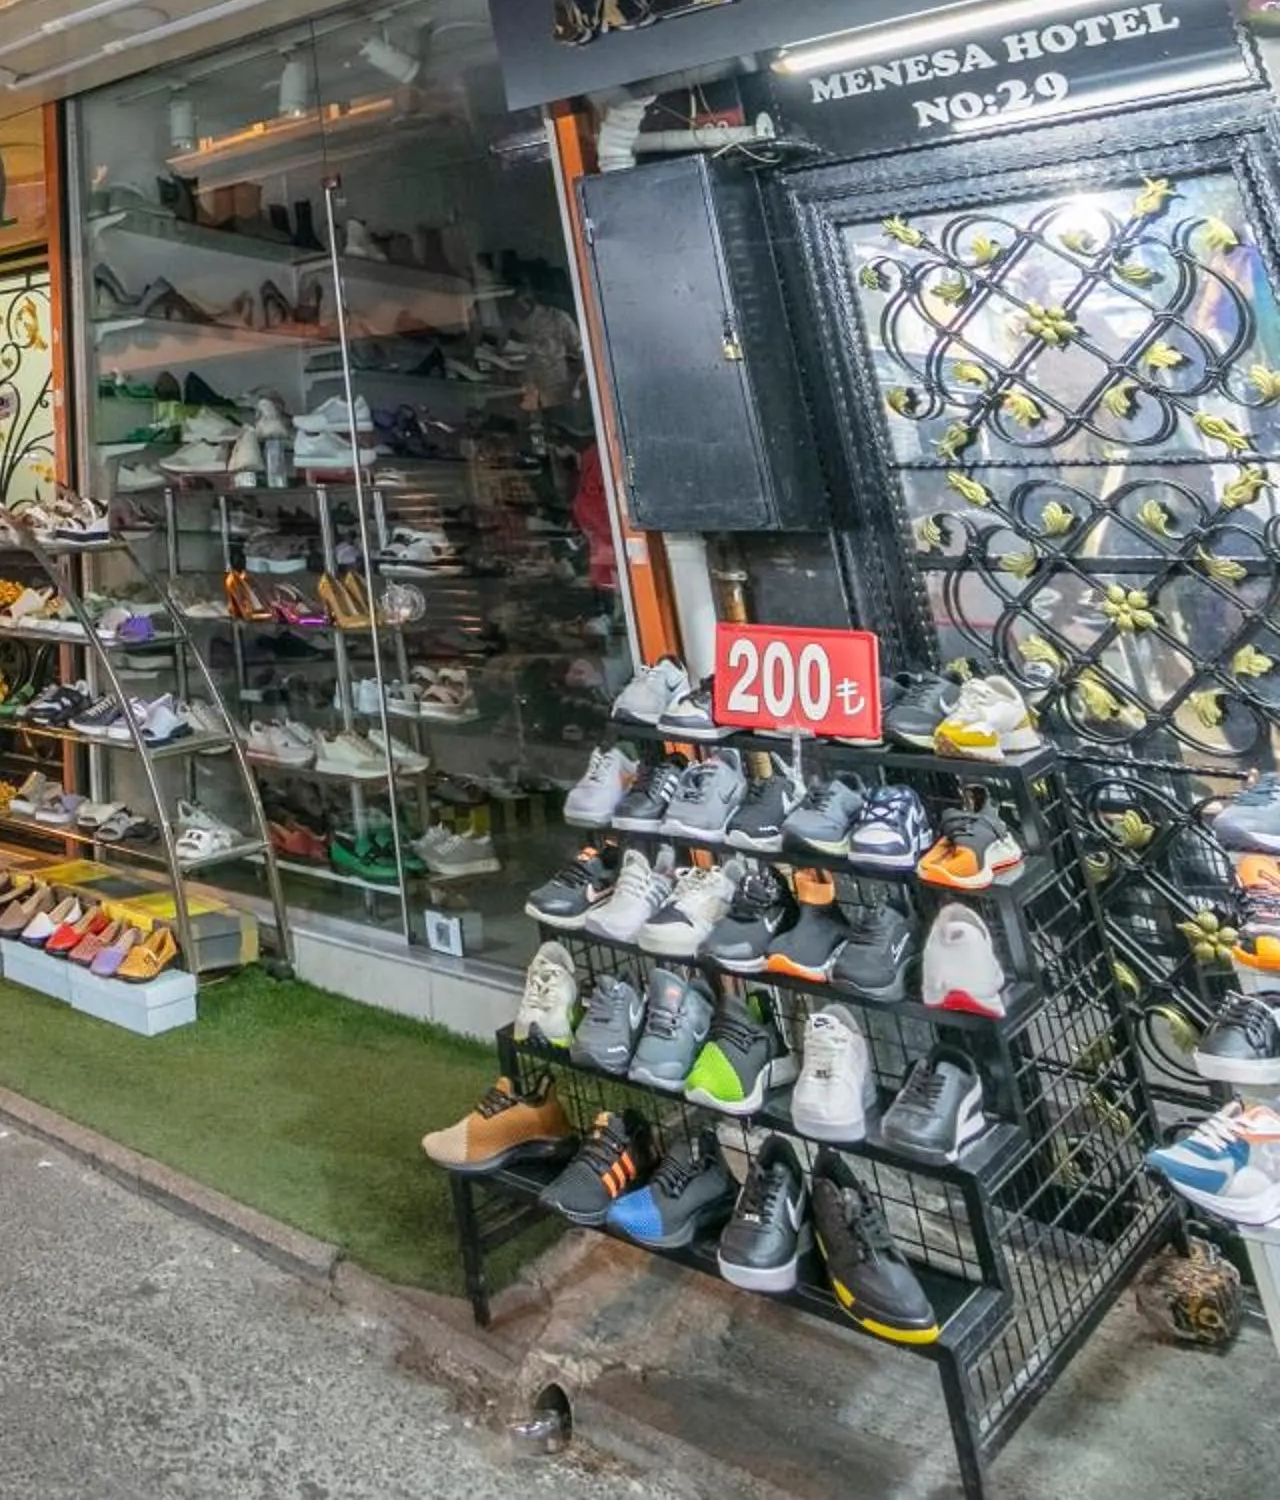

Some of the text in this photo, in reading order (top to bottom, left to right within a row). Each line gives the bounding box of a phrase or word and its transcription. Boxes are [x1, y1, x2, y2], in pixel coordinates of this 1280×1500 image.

[808, 3, 1181, 104] MENESA HOTEL
[911, 72, 1069, 128] NO:29
